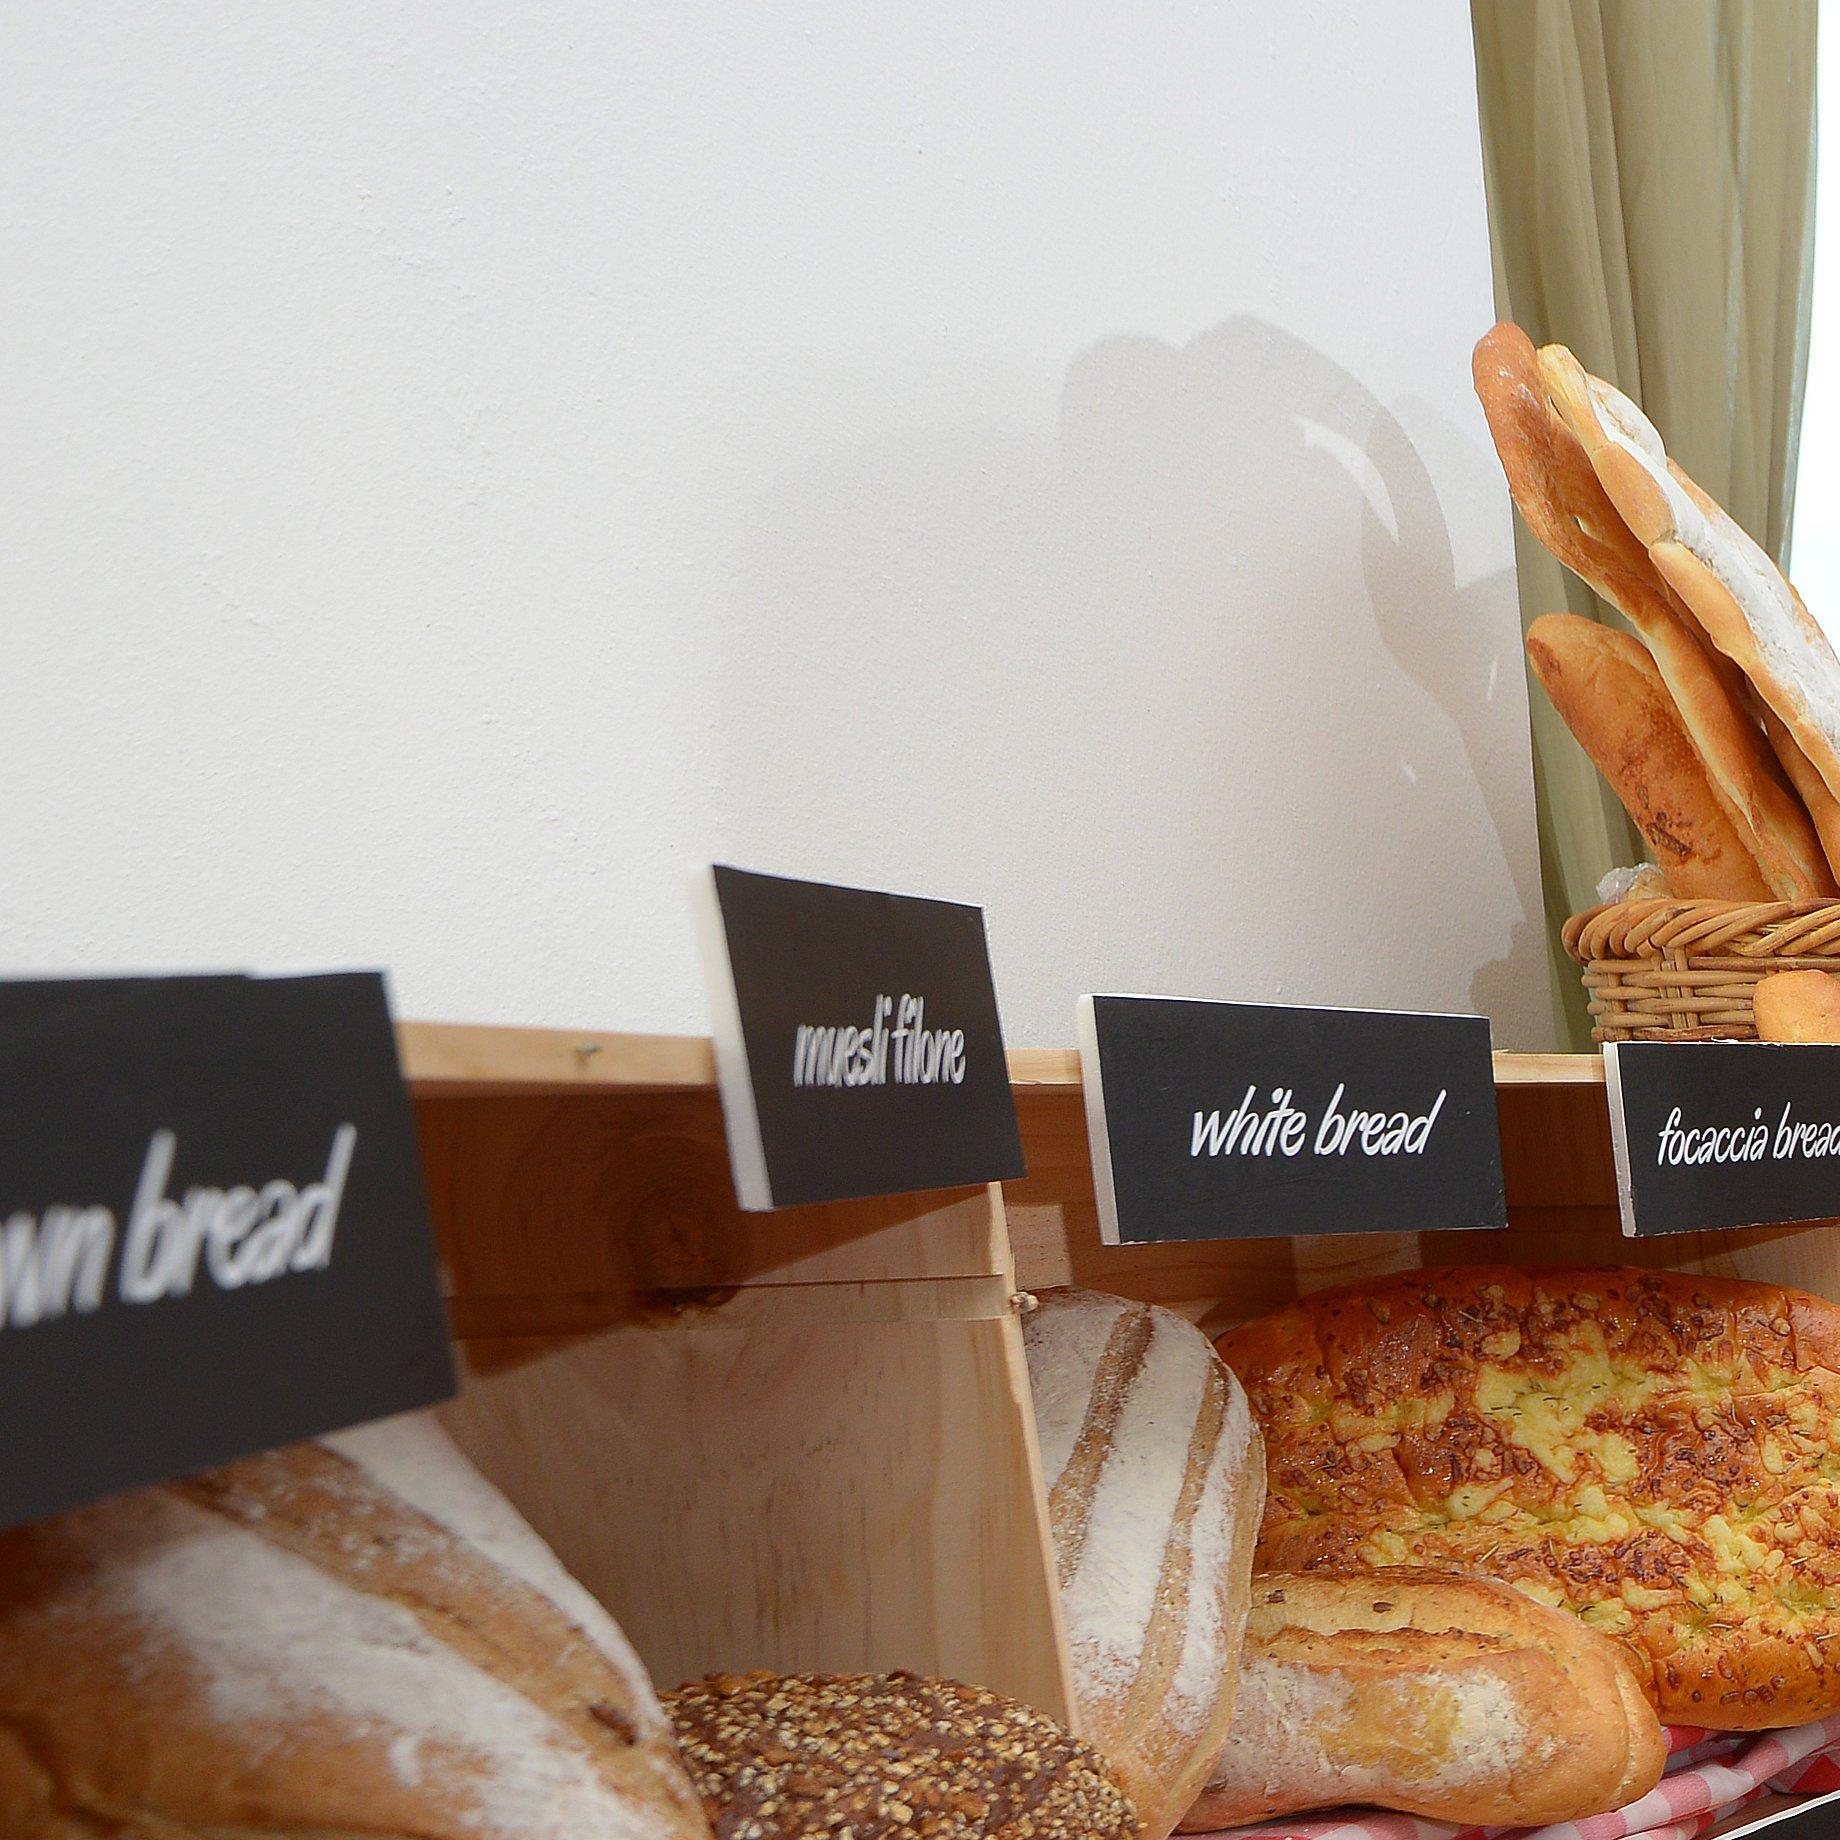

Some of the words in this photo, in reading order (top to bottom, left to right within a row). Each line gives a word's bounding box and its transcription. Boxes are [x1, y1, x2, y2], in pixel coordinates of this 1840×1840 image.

[793, 993, 892, 1088] muesli
[891, 993, 967, 1085] filone
[1190, 1084, 1307, 1157] white
[1313, 1082, 1447, 1157] bread
[1657, 1106, 1769, 1166] focaccia
[120, 1121, 358, 1304] bread
